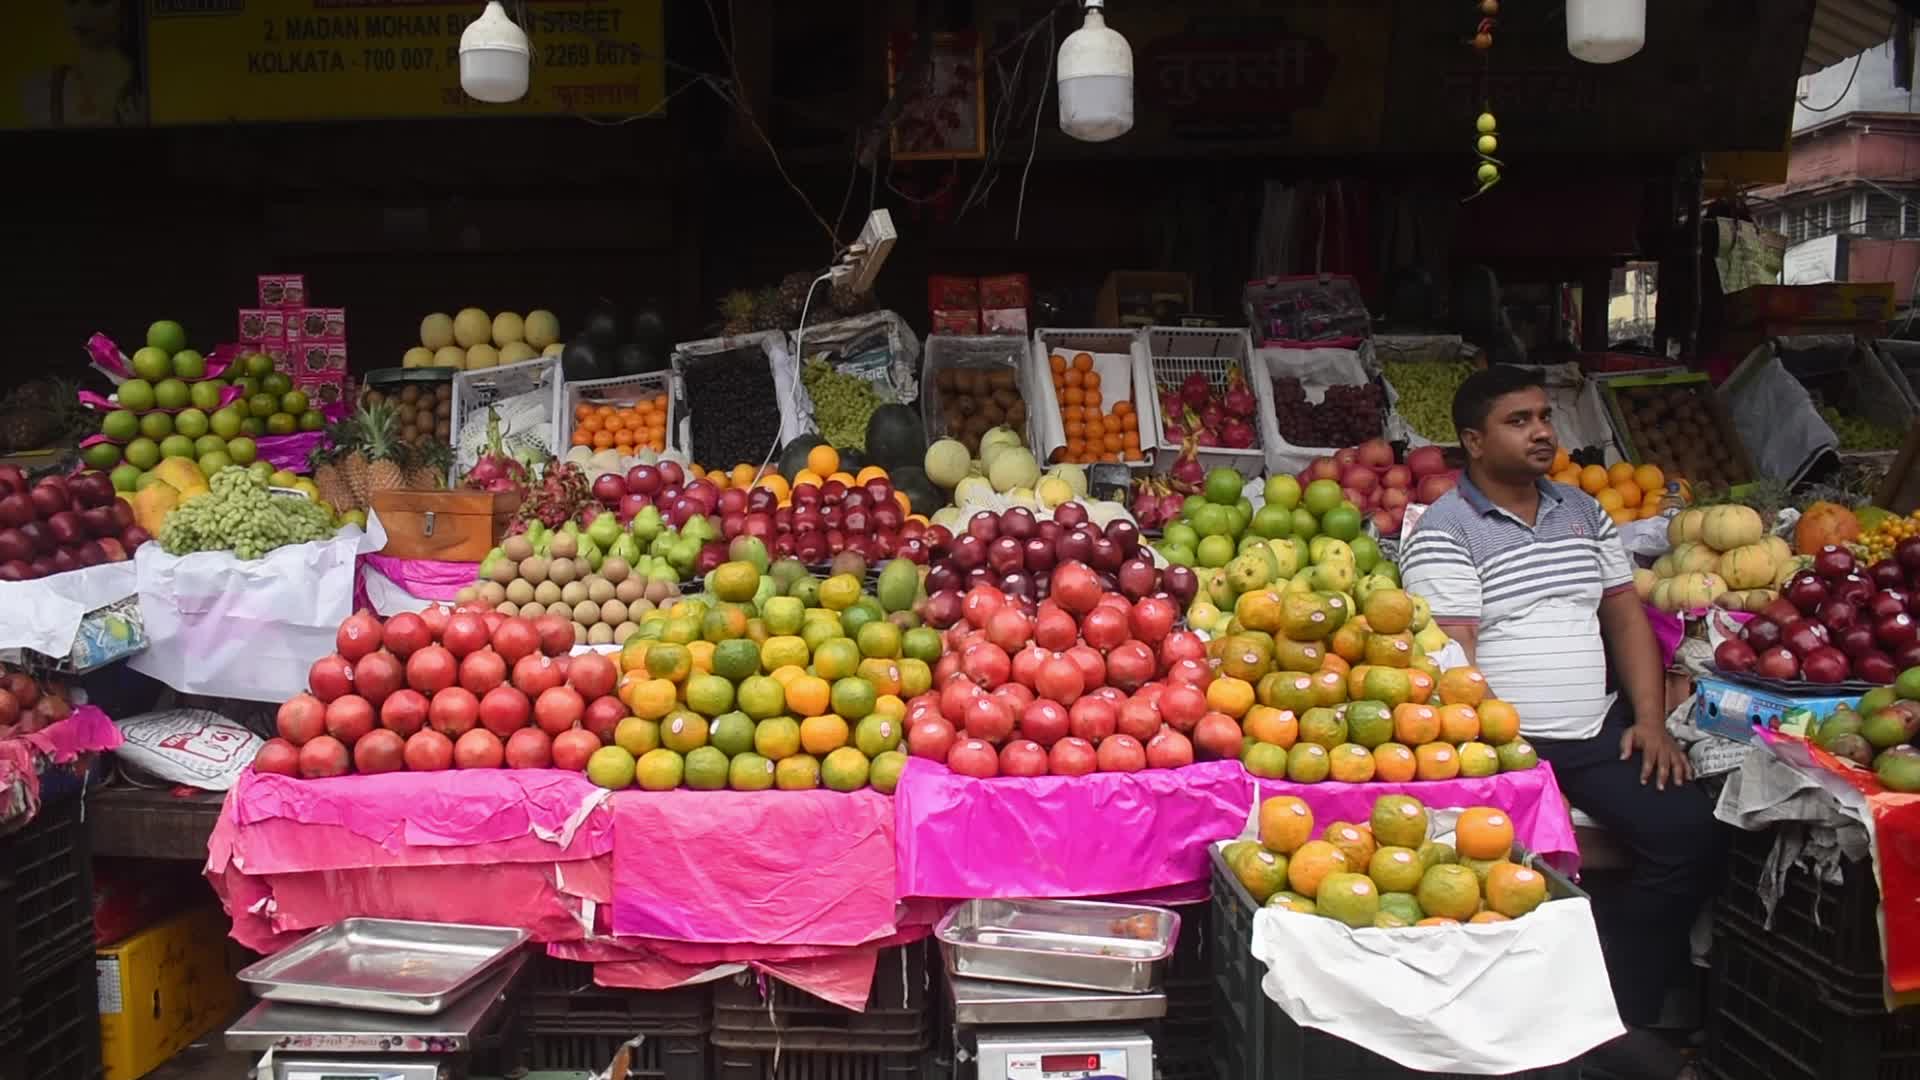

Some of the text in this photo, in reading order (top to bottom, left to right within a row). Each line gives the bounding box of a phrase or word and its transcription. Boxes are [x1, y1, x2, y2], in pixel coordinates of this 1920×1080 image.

[287, 17, 358, 40] MADAN
[366, 16, 440, 39] MOHAN
[543, 8, 623, 33] STREET
[248, 50, 344, 73] KOLKATA
[363, 48, 393, 71] 700
[1154, 42, 1312, 105] तुलसी
[1088, 1057, 1097, 1070] 0
